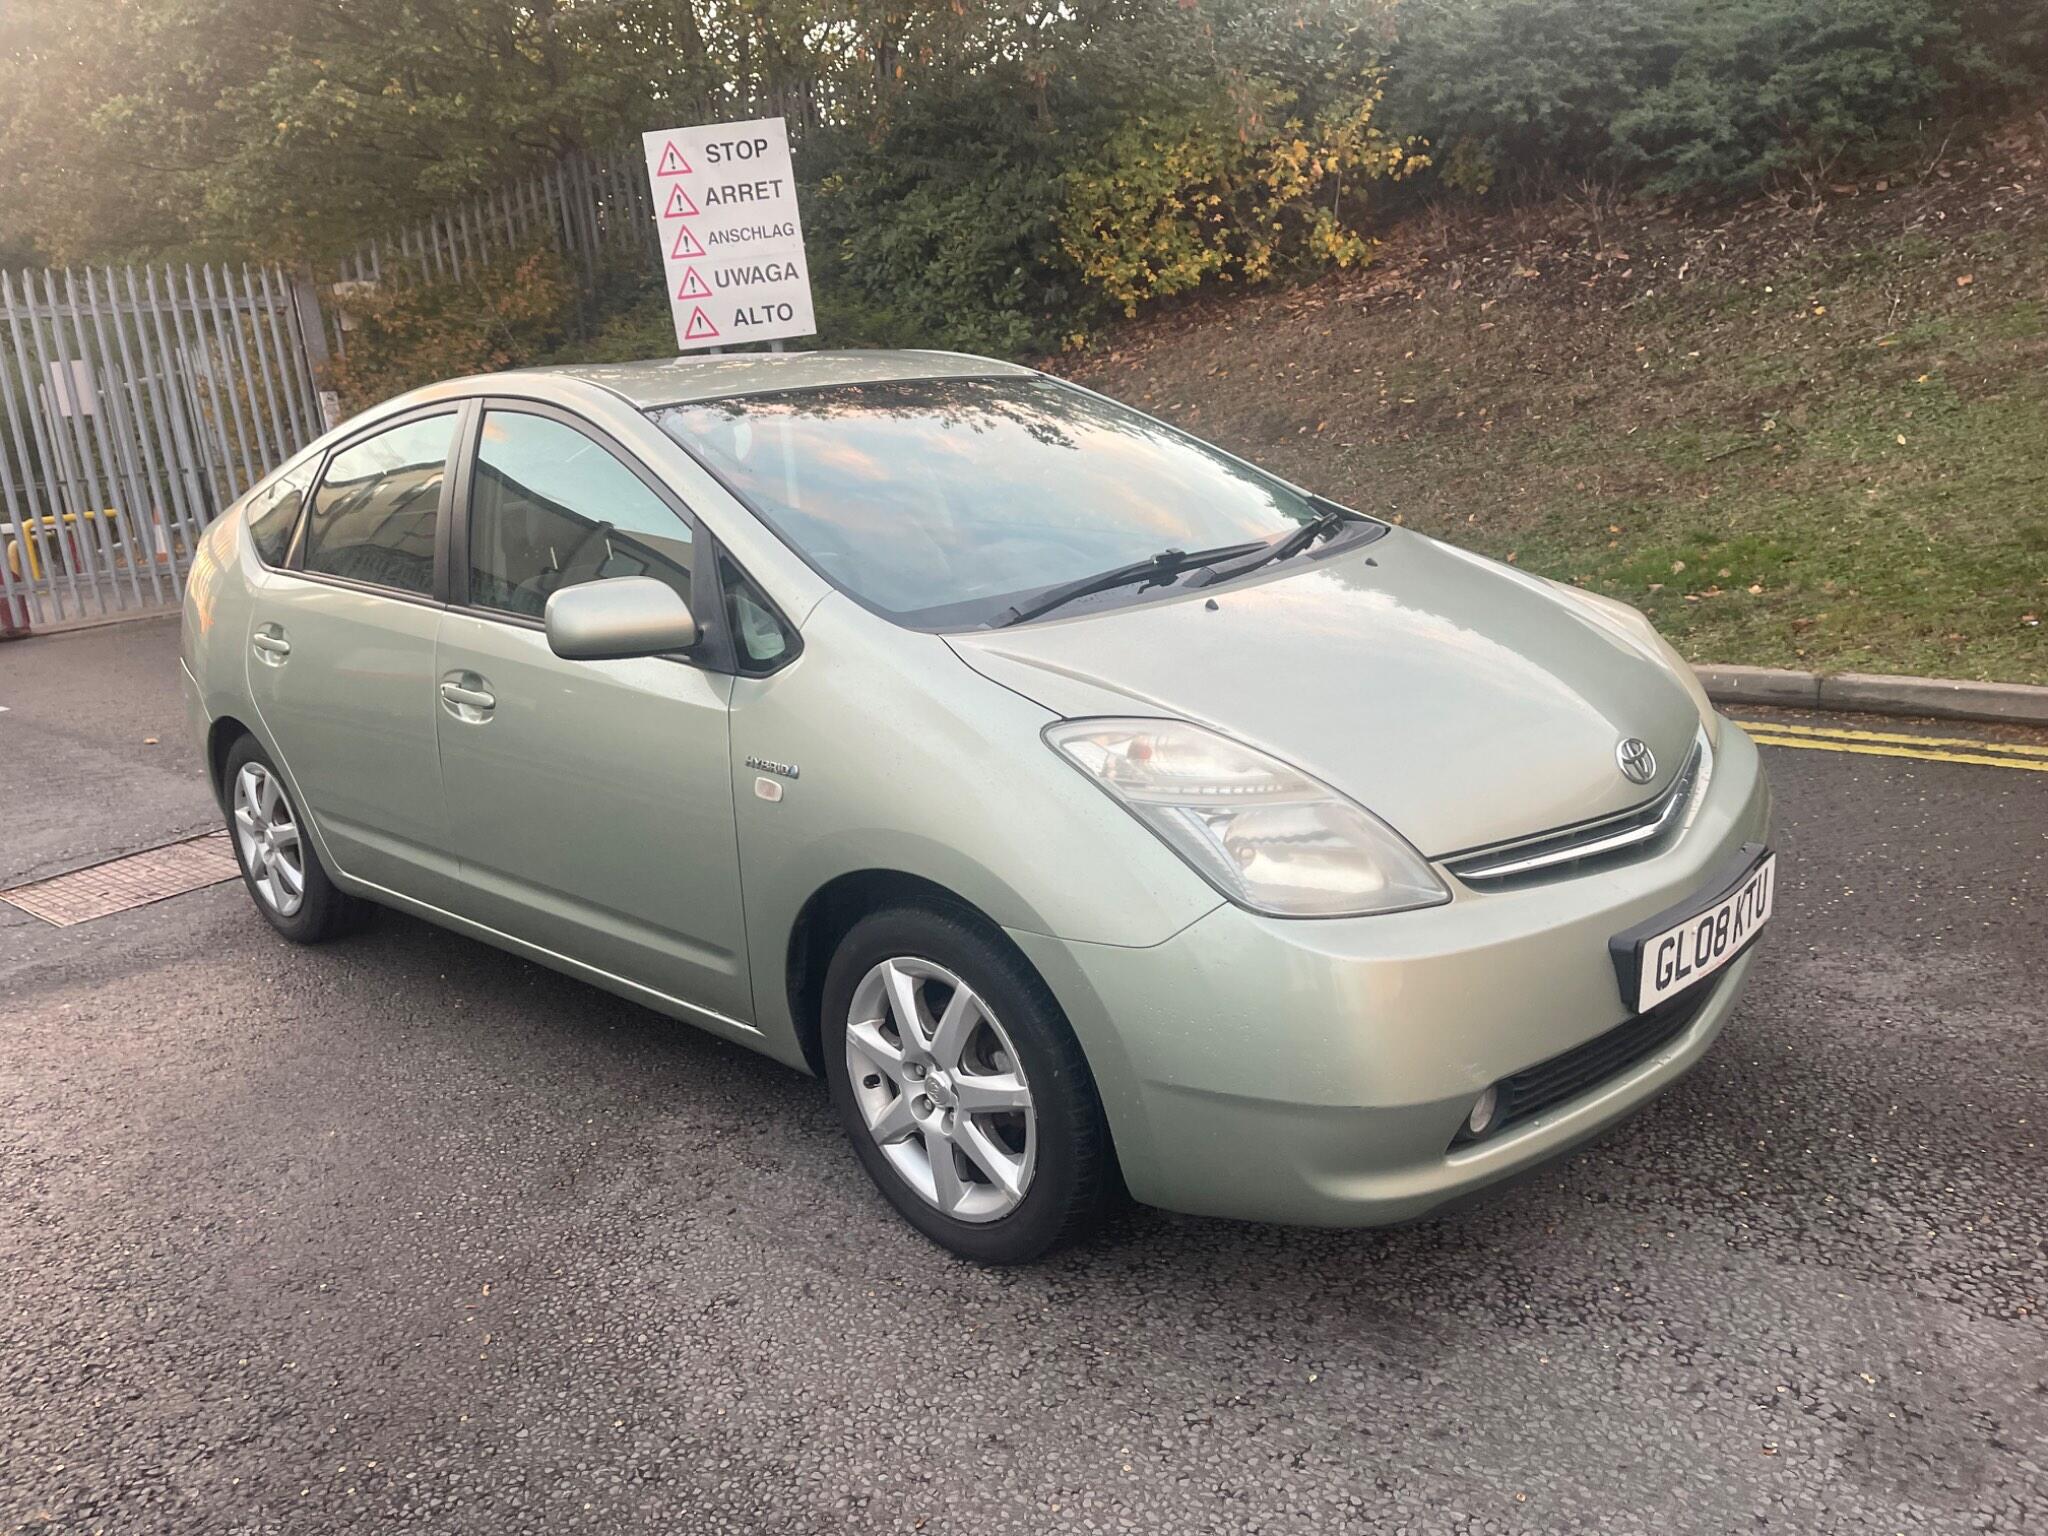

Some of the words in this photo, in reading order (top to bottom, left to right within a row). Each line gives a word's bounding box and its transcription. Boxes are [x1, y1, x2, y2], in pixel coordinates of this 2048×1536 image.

[705, 138, 768, 163] STOP
[705, 179, 783, 206] ARRET
[708, 222, 795, 245] ANSCHLAG
[714, 262, 799, 288] UWAGA
[733, 303, 793, 327] ALTO
[1733, 867, 1768, 944] KTU
